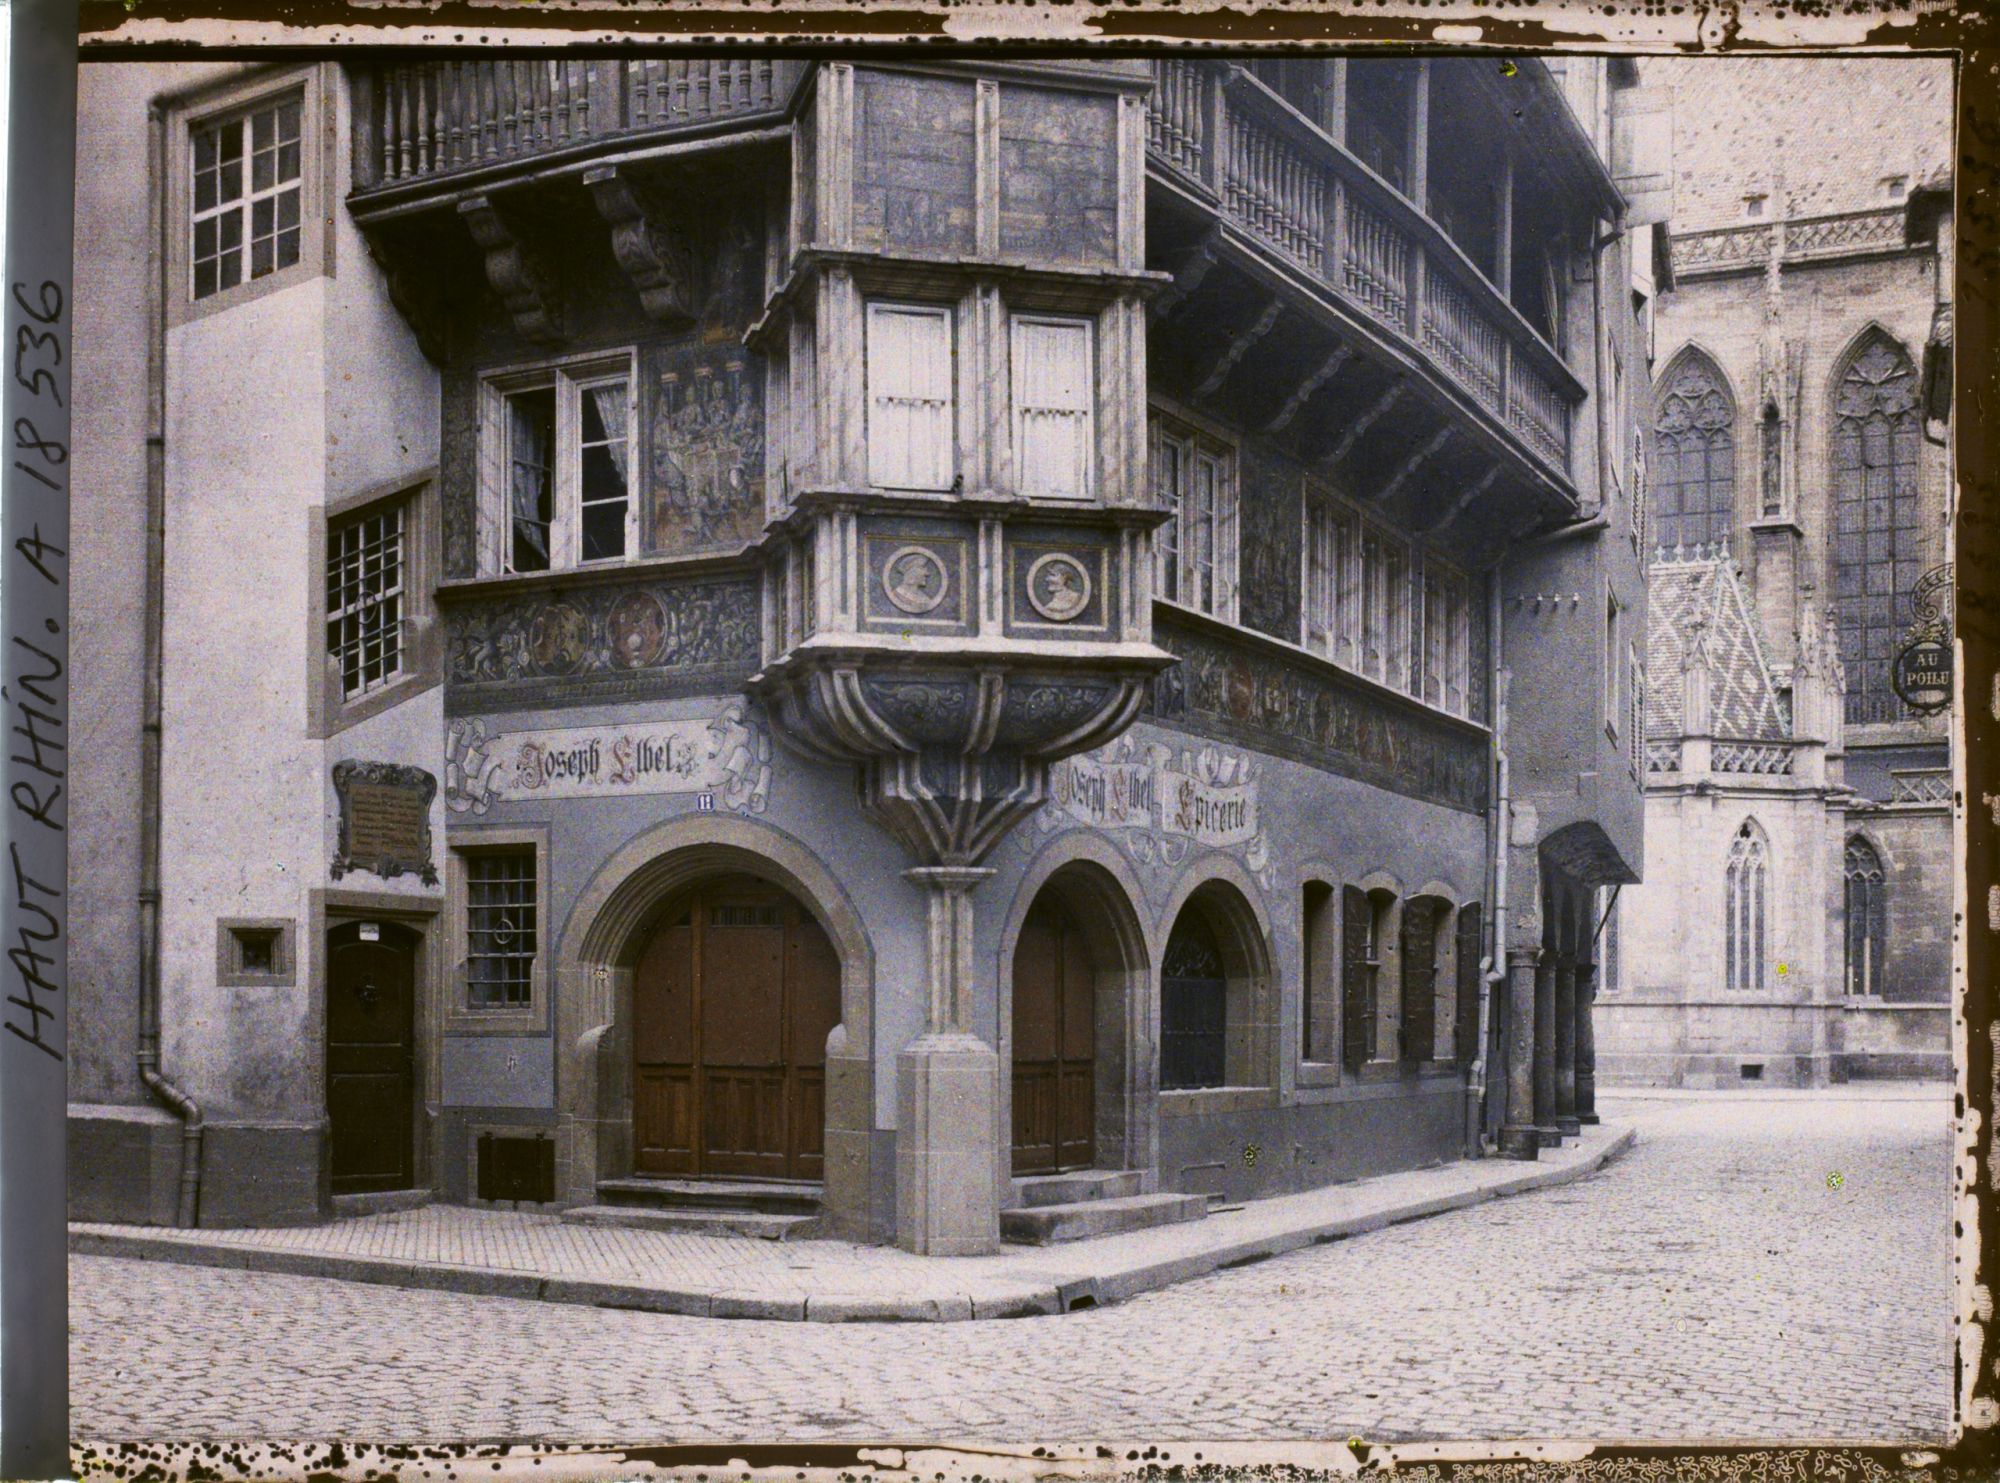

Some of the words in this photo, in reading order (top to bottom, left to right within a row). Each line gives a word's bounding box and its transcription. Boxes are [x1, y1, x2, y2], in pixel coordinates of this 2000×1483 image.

[13, 523, 63, 584] A
[1906, 671, 1950, 686] POILU
[1917, 653, 1938, 666] AU
[513, 737, 601, 789] Joseph
[4, 842, 64, 1061] HAUT
